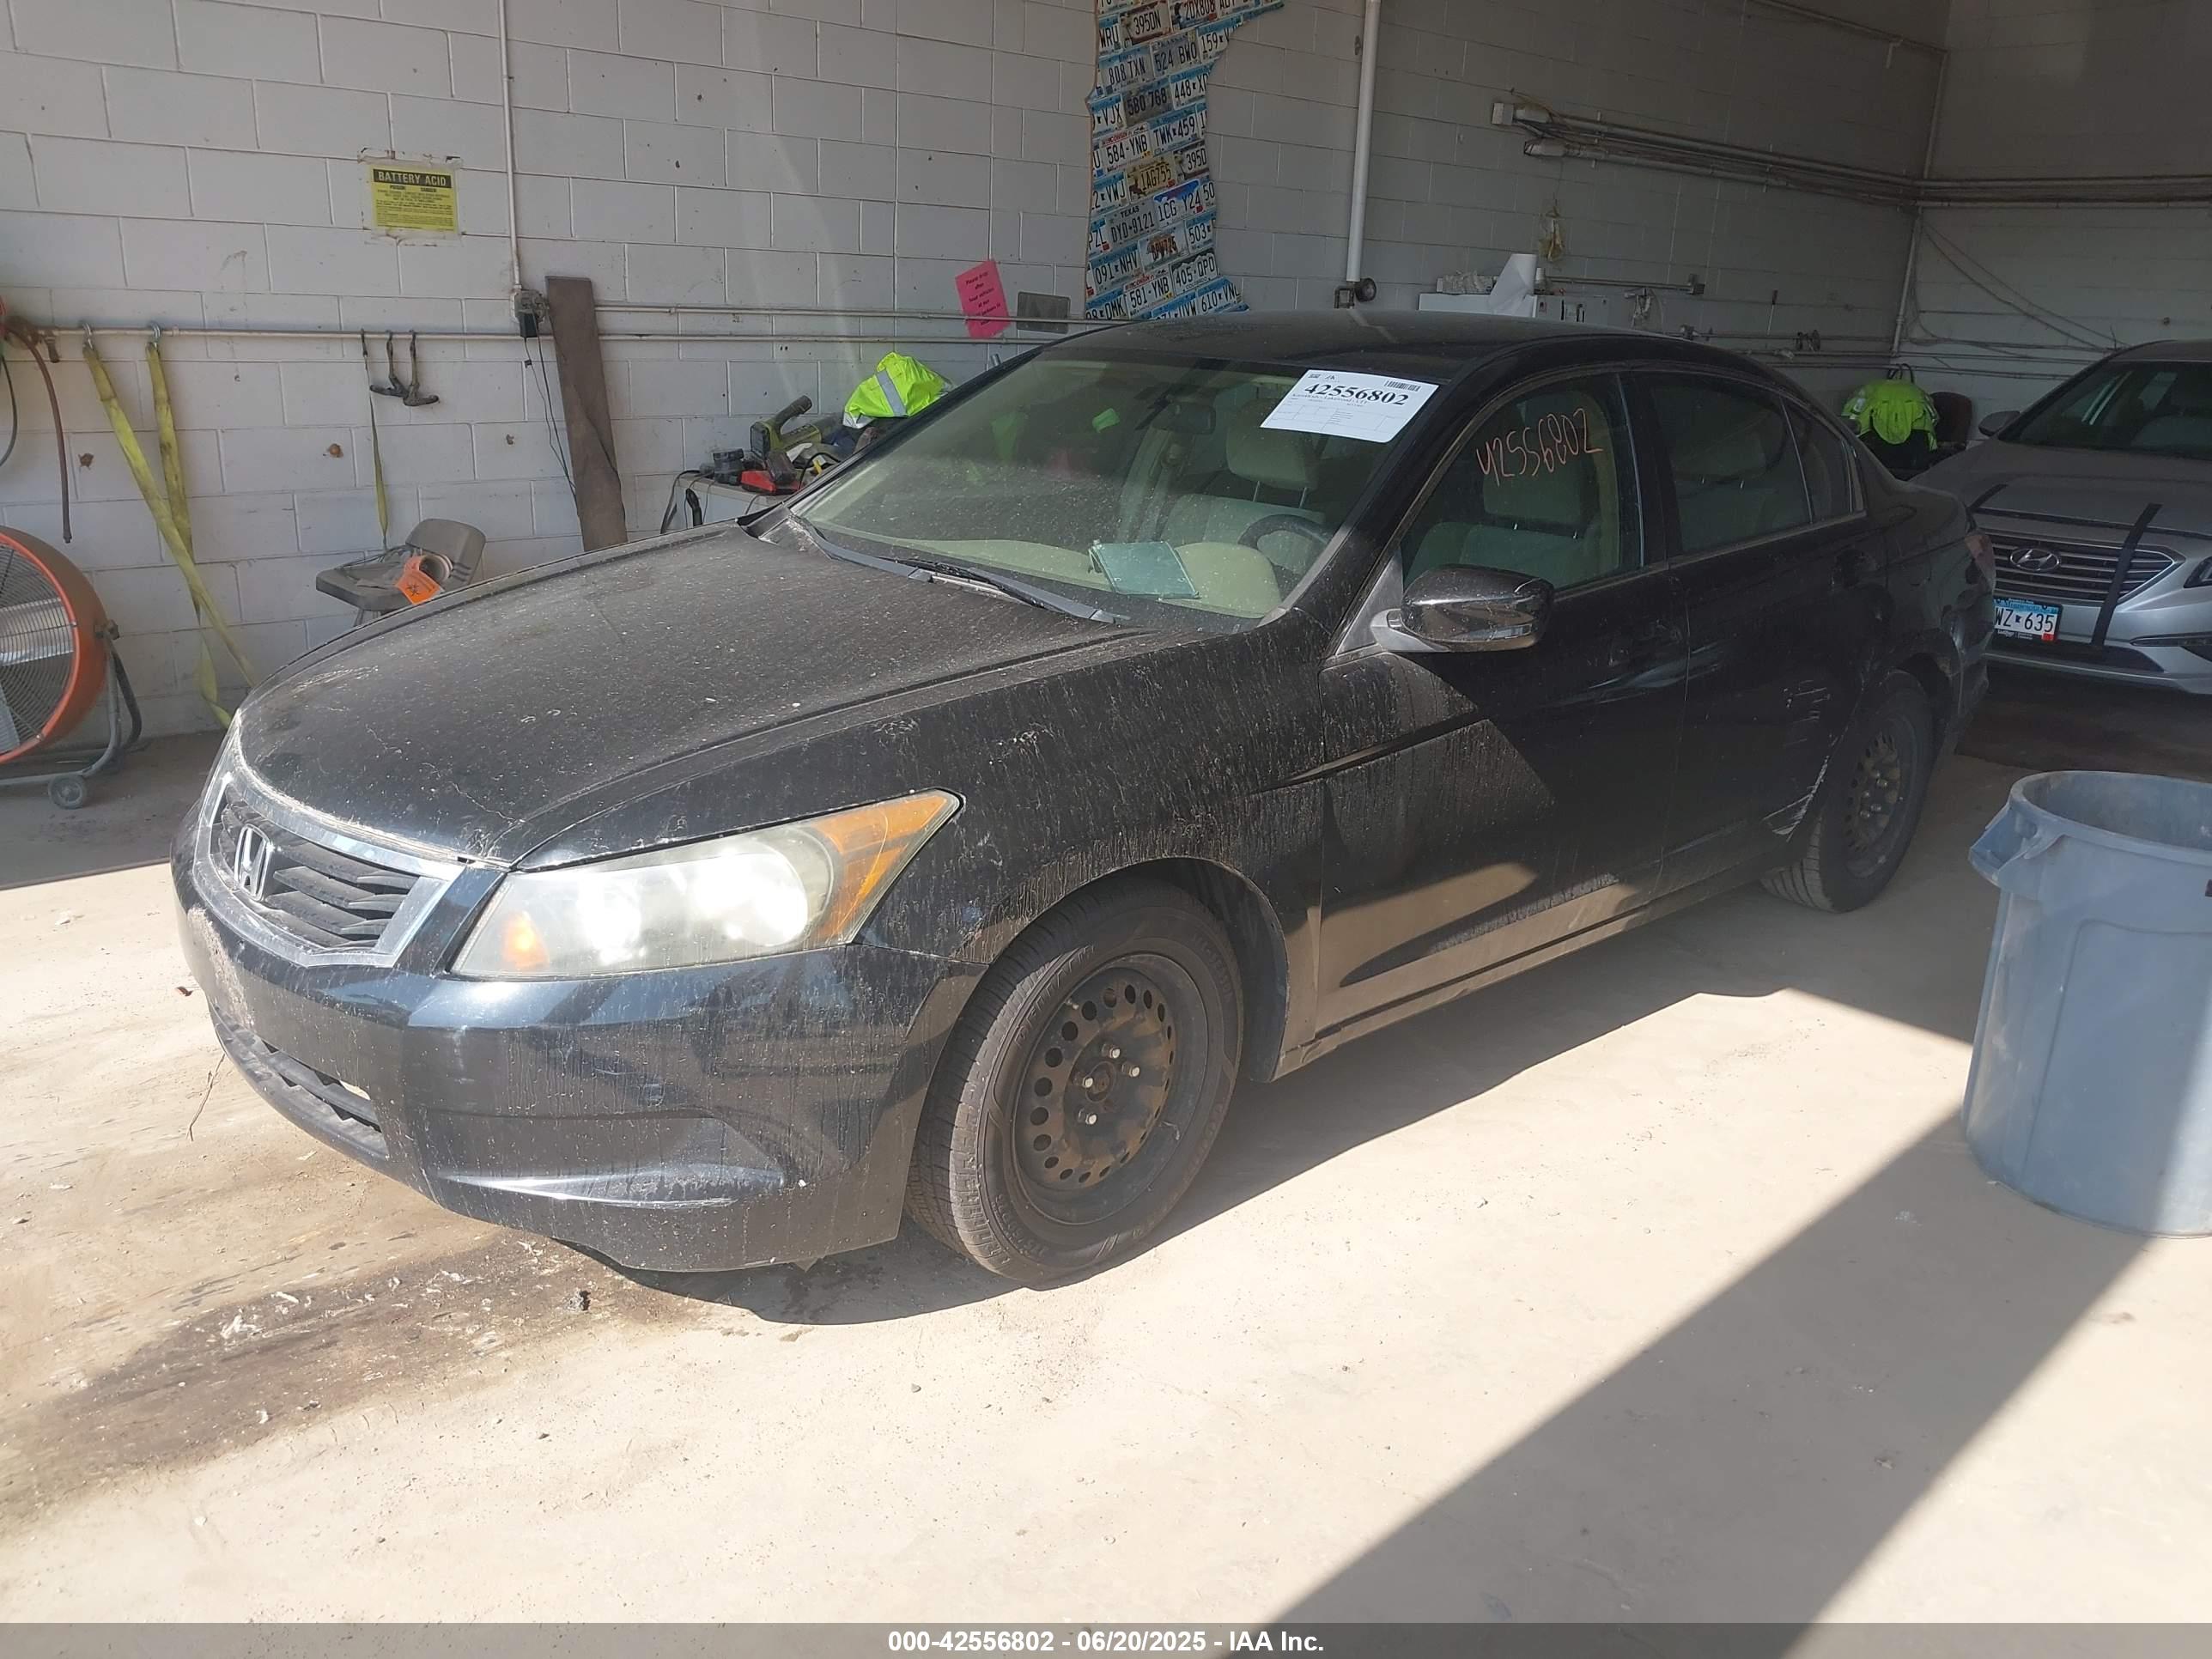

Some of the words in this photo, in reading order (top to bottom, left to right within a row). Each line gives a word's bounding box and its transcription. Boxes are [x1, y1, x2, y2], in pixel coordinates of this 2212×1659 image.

[1108, 64, 1127, 85] 808
[1127, 57, 1146, 78] TXN
[1154, 50, 1174, 72] 524
[1175, 79, 1192, 100] 448
[1177, 116, 1195, 137] 459
[378, 171, 421, 184] BATTERY
[425, 175, 447, 186] ACID
[1121, 206, 1139, 218] TEXAS
[1188, 222, 1206, 245] 503
[1202, 290, 1218, 312] 610
[1304, 382, 1409, 406] 42556802
[1476, 408, 1604, 488] 42556802
[2025, 612, 2055, 633] 635
